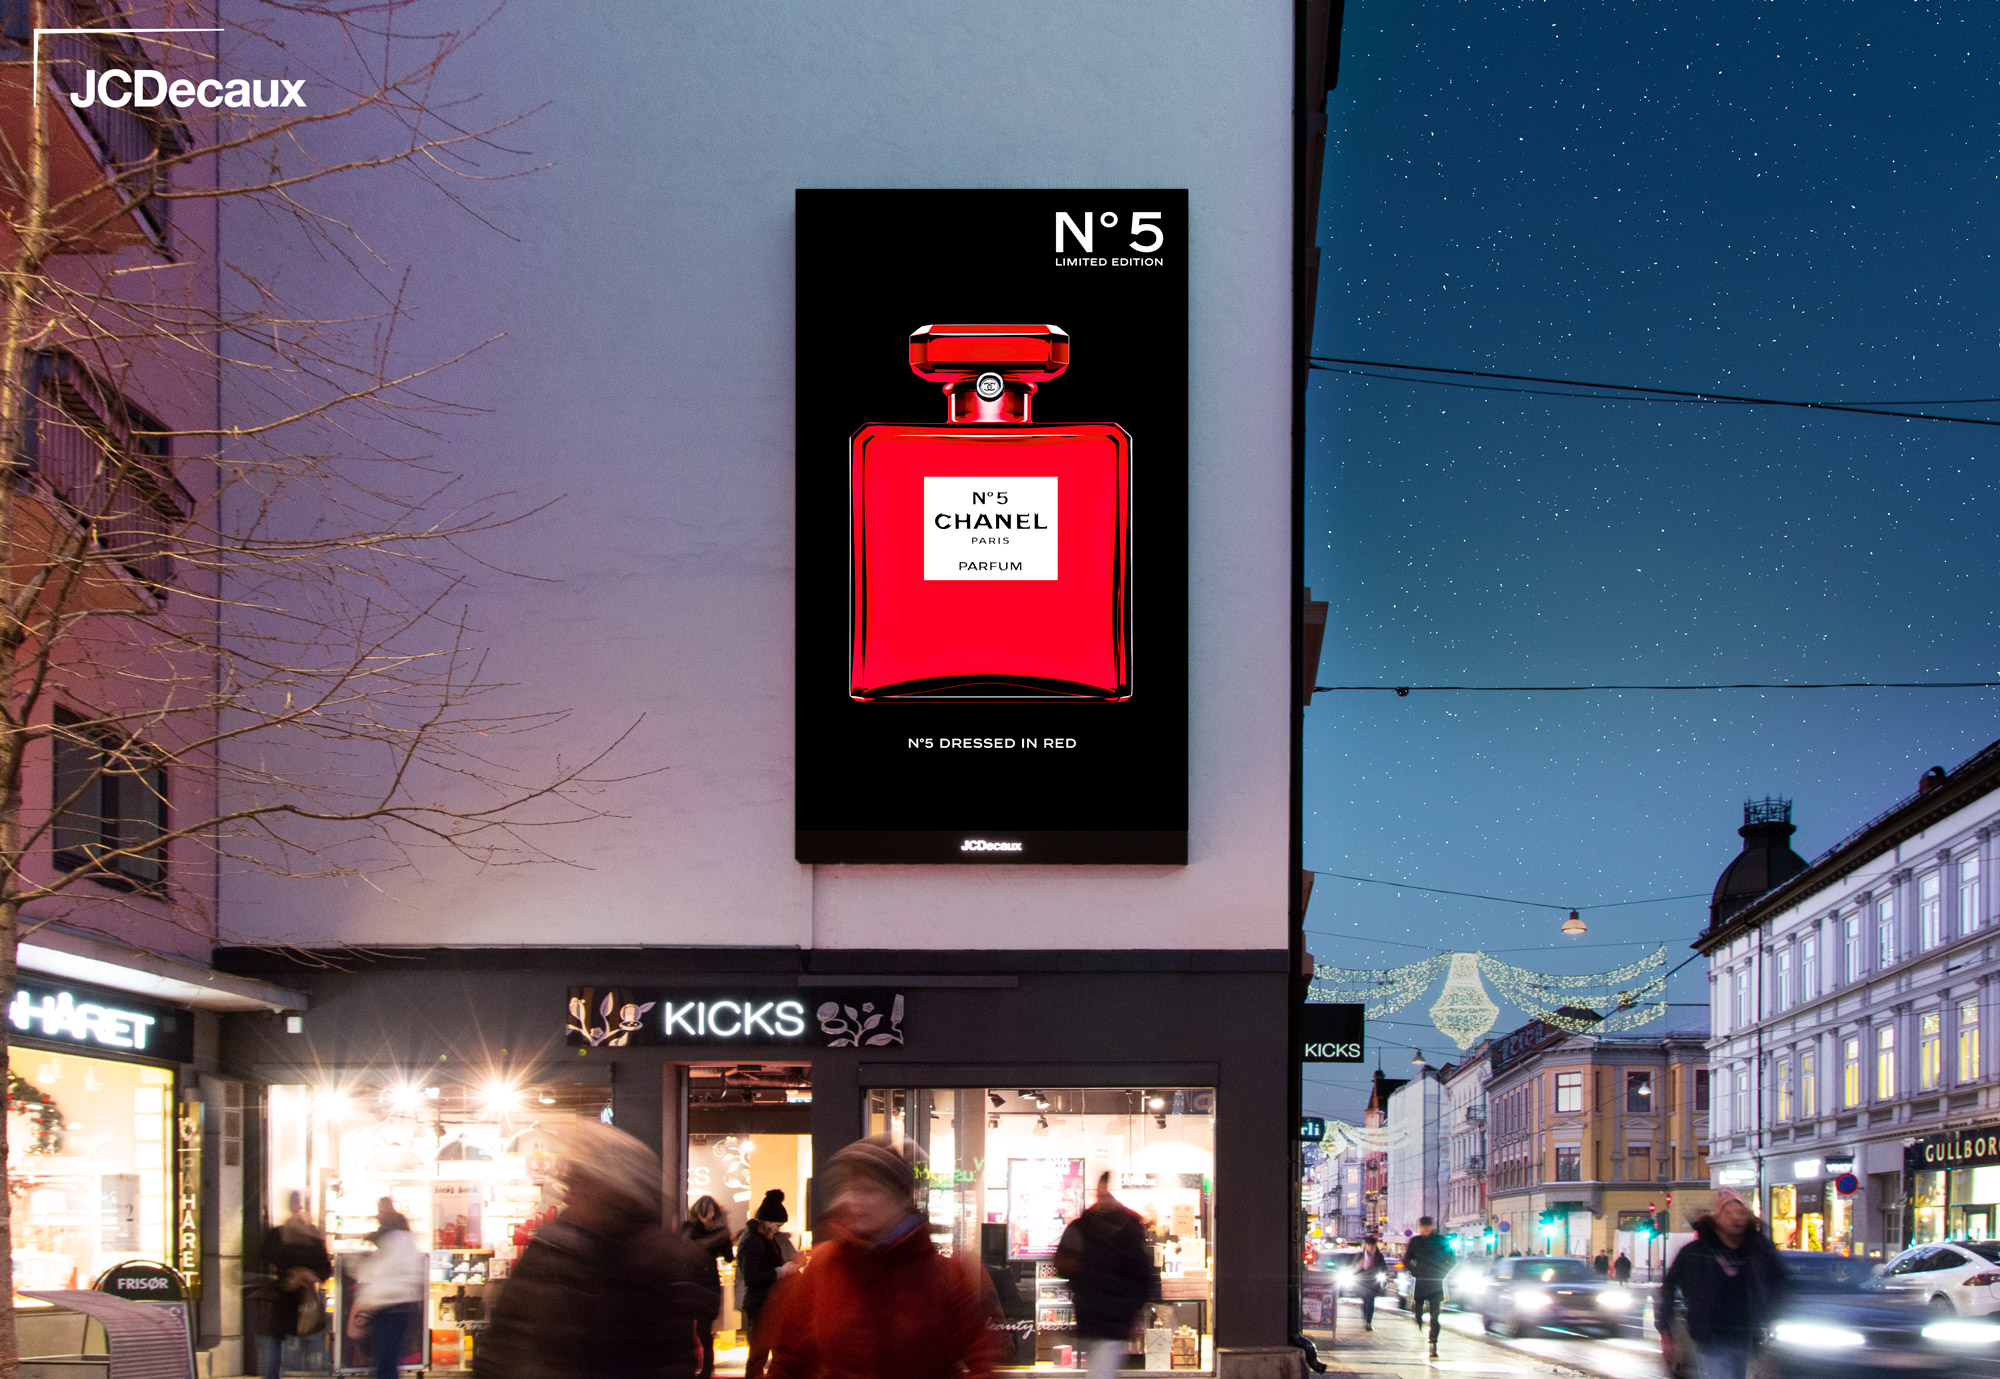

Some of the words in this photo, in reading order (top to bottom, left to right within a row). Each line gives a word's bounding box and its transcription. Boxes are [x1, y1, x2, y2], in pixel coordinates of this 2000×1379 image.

[1055, 257, 1108, 267] LIMITED
[1111, 257, 1164, 267] EDITION
[934, 512, 1048, 530] CHANEL
[971, 537, 1010, 545] PARIS
[958, 561, 1023, 572] PARFUM
[939, 737, 1016, 749] DRESSED
[1021, 737, 1038, 749] IN
[1043, 737, 1077, 749] RED
[961, 840, 1023, 852] JCDecaux
[664, 1000, 806, 1037] KICKS
[1304, 1042, 1361, 1058] KICKS
[1925, 1136, 2000, 1163] GULLBOR
[117, 1276, 169, 1291] FRISØR
[985, 1317, 1036, 1340] beauty
